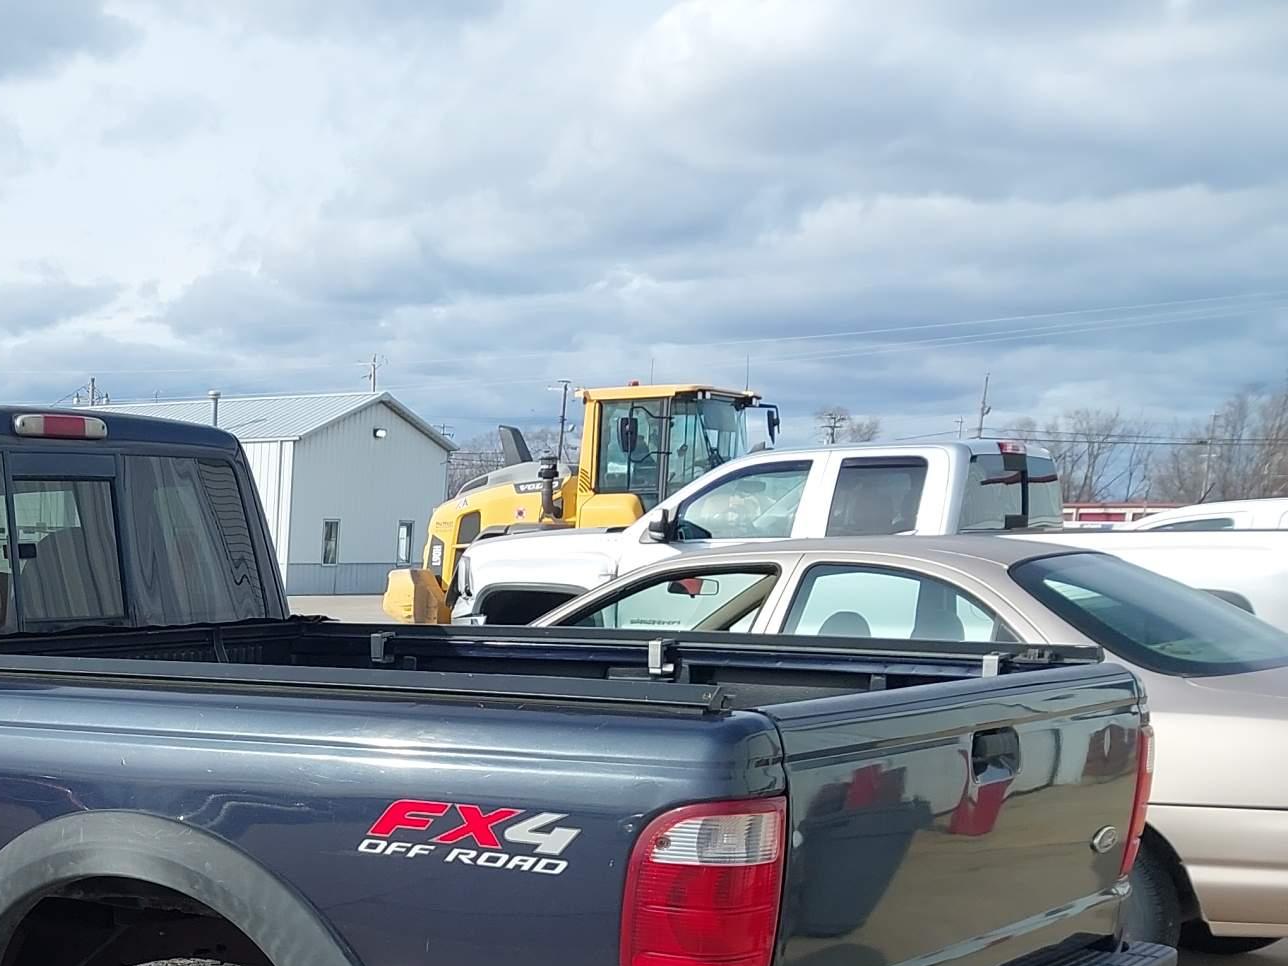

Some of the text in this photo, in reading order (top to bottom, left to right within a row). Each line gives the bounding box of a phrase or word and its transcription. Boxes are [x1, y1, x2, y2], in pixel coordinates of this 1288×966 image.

[519, 481, 560, 491] VOLO
[367, 799, 582, 856] FX4
[357, 838, 569, 875] OFF ROAD
